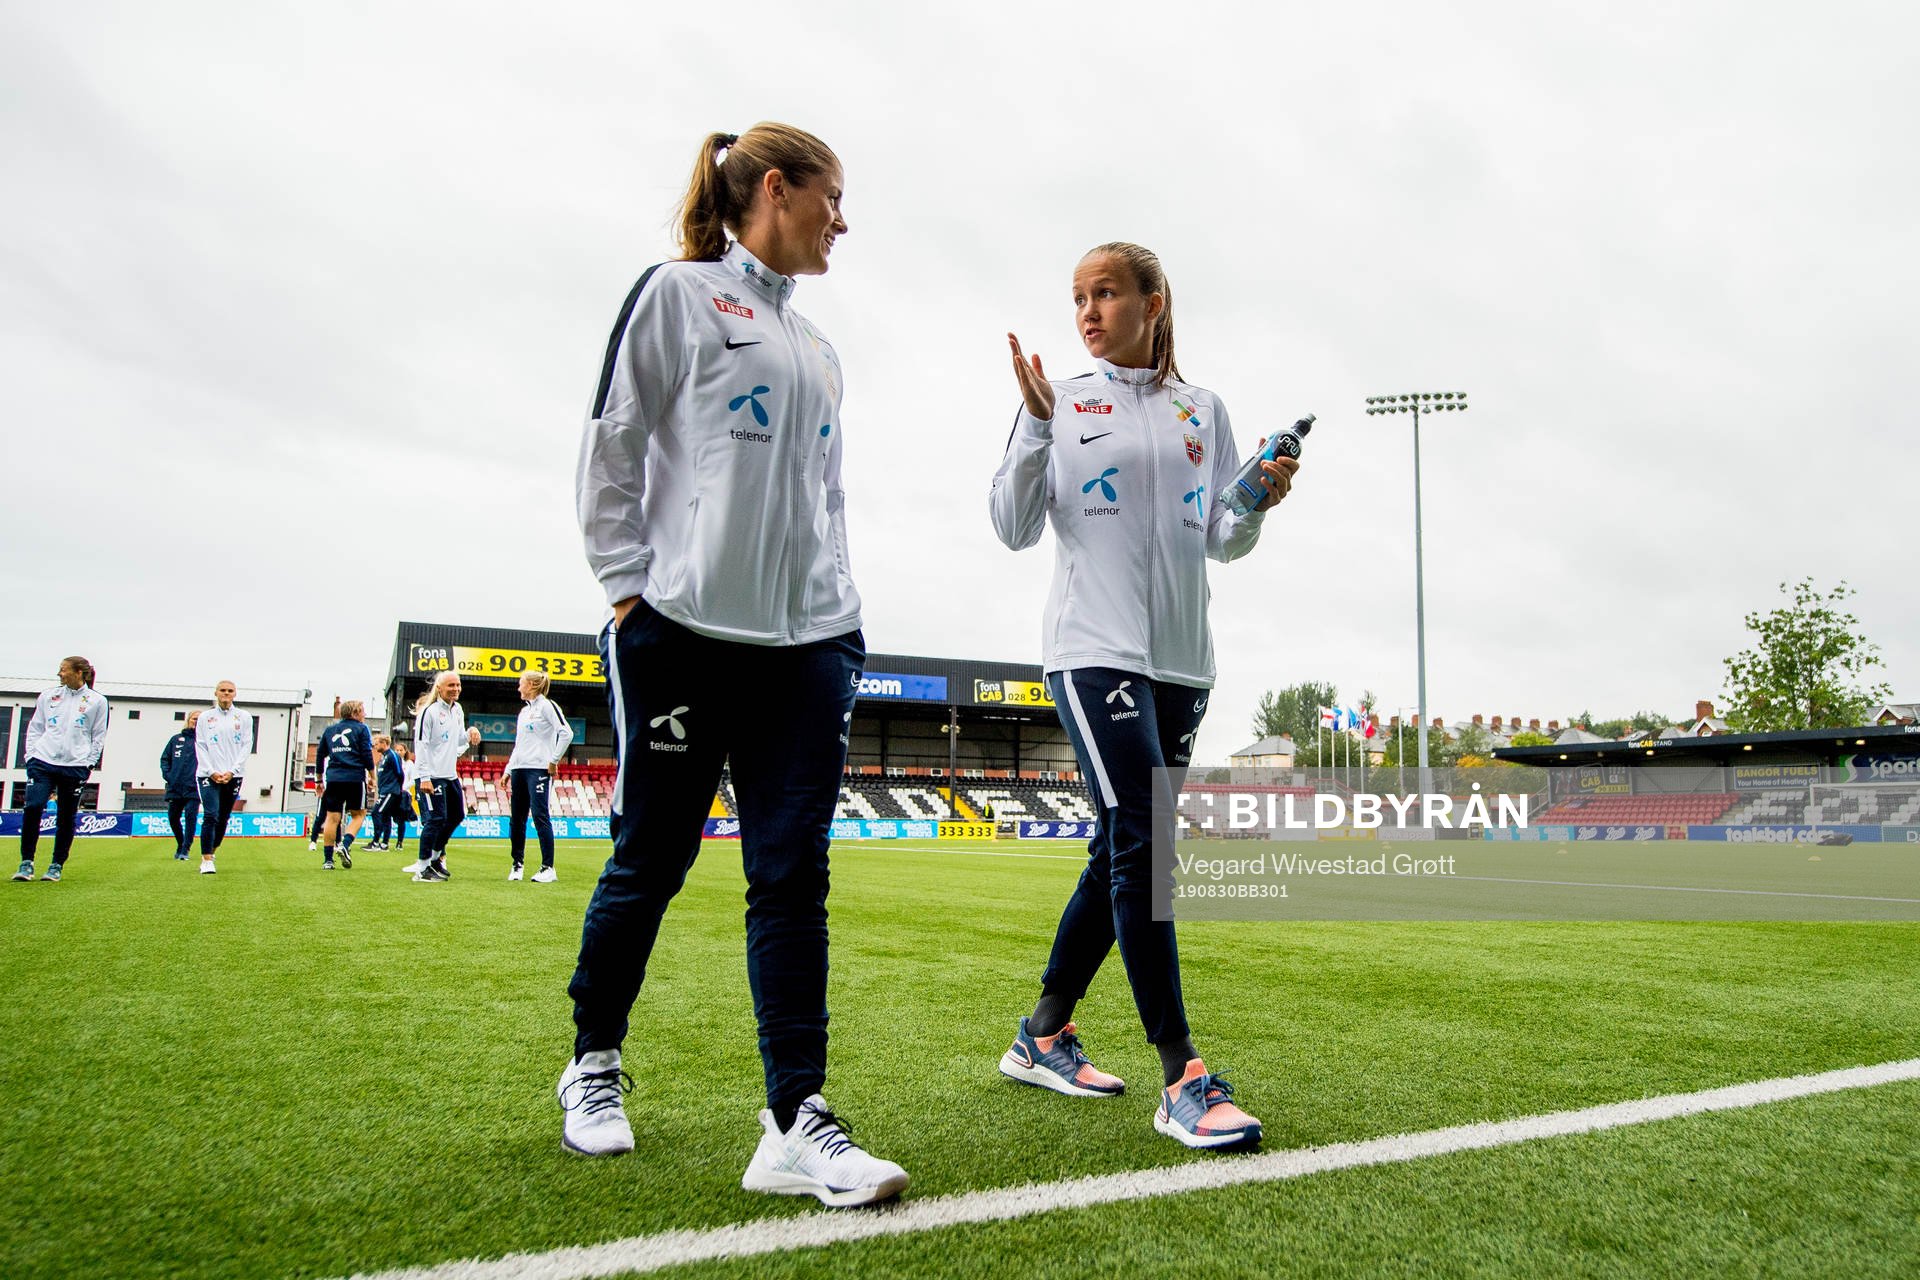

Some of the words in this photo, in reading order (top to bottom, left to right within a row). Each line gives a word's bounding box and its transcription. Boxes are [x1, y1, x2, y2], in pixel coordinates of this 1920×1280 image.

[717, 300, 752, 317] TINE
[1079, 405, 1109, 413] TINE
[730, 428, 773, 443] telenor
[1084, 506, 1121, 517] telenor
[418, 647, 447, 659] fona
[417, 658, 449, 671] CAB
[458, 661, 483, 671] 028
[490, 655, 527, 673] 90
[980, 682, 1000, 692] fona
[979, 691, 1003, 702] CAB
[1008, 693, 1026, 701] 028
[1111, 710, 1140, 721] telenor
[650, 740, 689, 752] telenor
[1736, 768, 1780, 778] BANGOR
[1783, 766, 1818, 776] FUELS
[76, 815, 118, 833] Boots
[252, 815, 296, 826] electric
[461, 817, 500, 828] electric
[939, 826, 964, 837] 333
[968, 826, 992, 837] 333
